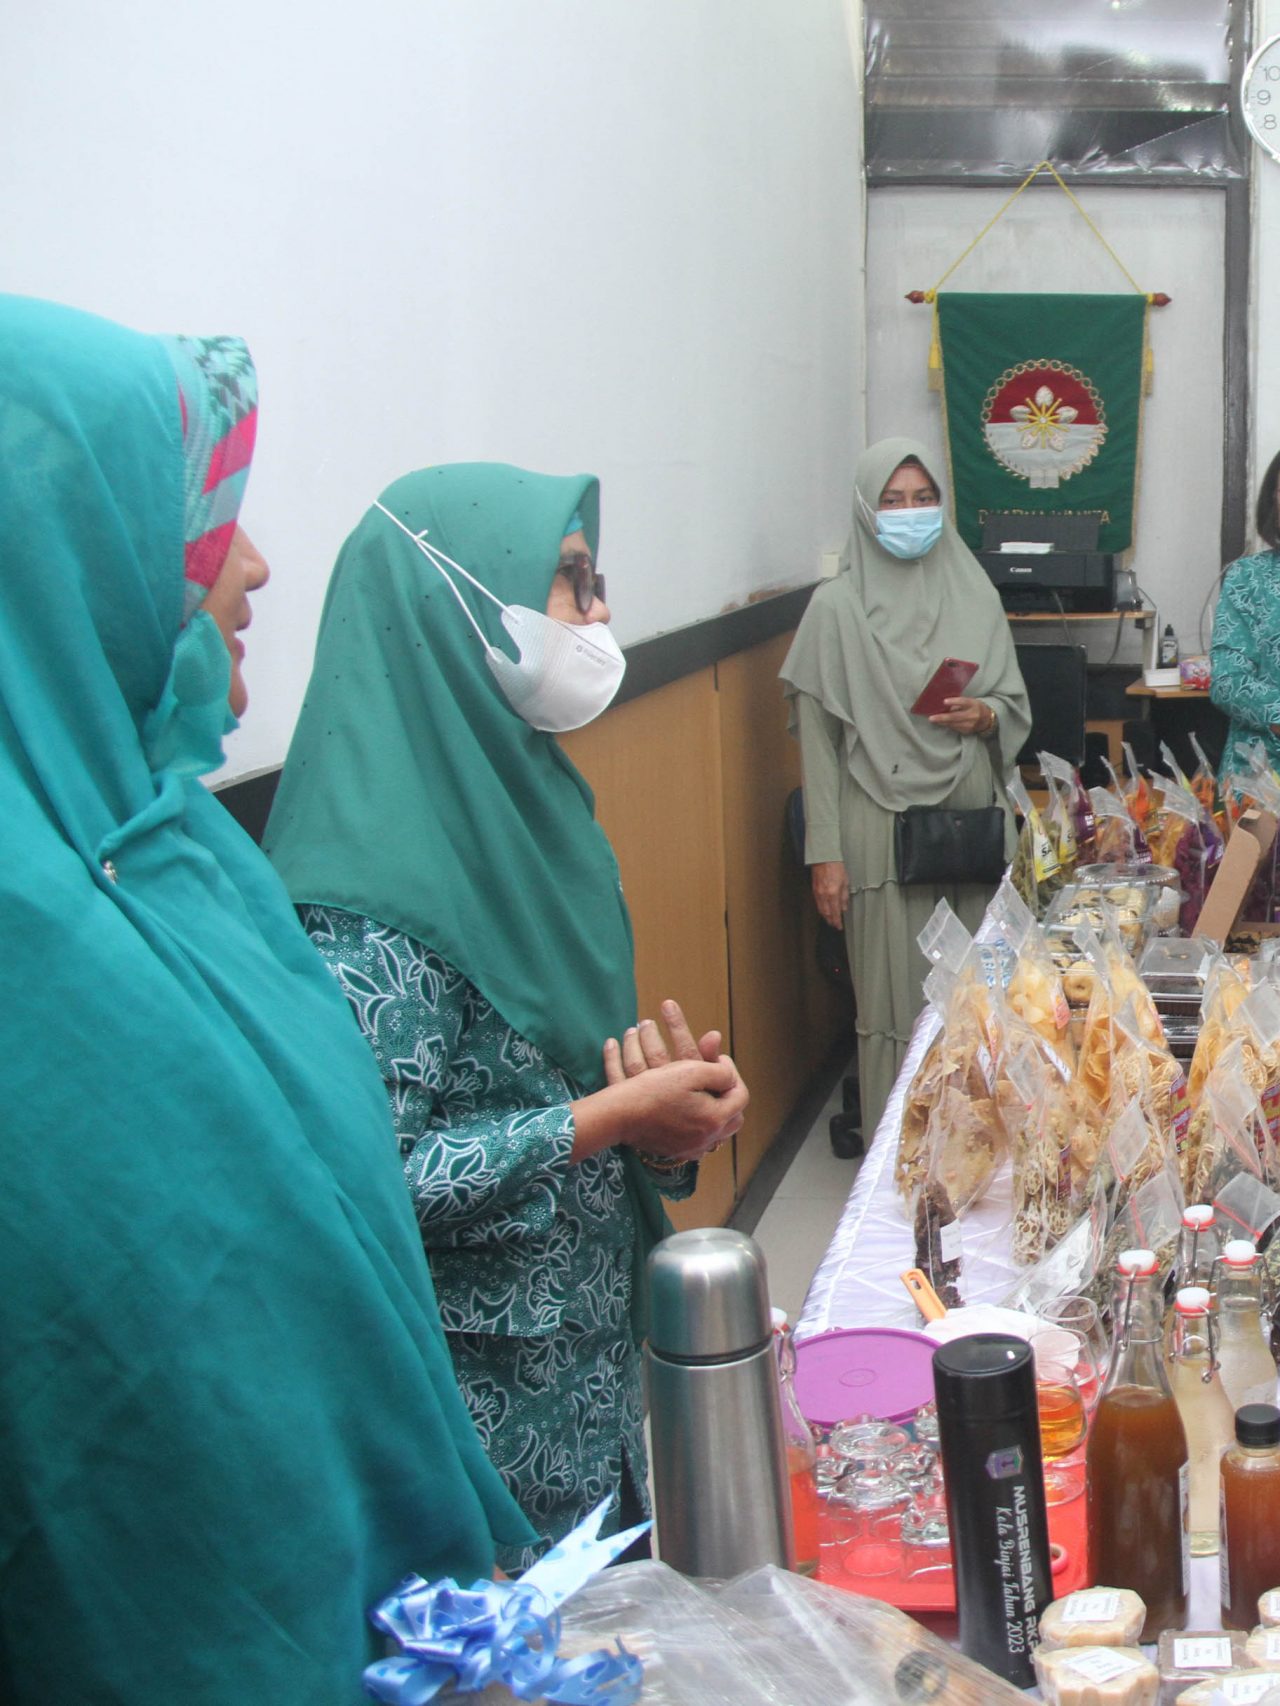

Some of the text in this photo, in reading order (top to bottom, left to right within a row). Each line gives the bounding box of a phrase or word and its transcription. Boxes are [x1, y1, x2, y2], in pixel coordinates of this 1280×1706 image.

[1257, 90, 1271, 105] 9
[1264, 115, 1277, 129] 8
[994, 1539, 1016, 1577] Binjai
[1013, 1485, 1036, 1612] MUSRENBANG
[1003, 1581, 1020, 1617] Tahun
[1007, 1621, 1025, 1653] 2023
